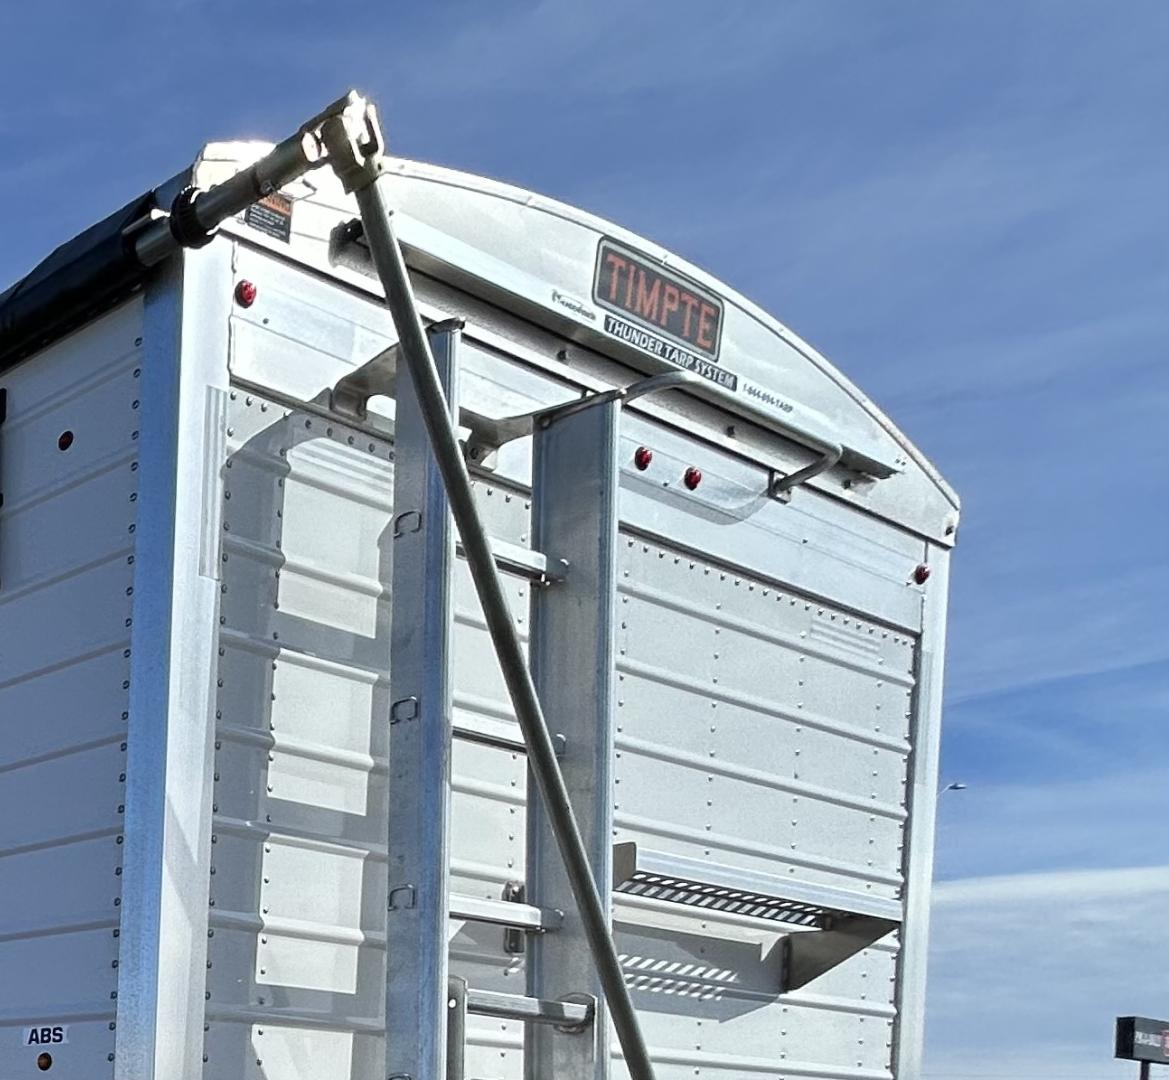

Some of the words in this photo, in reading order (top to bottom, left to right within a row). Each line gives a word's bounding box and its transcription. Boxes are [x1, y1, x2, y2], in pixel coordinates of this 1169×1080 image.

[606, 253, 716, 349] TIMPTE
[607, 317, 662, 355] THUNDER
[664, 344, 693, 368] TARP
[693, 359, 735, 389] SYSTEM
[28, 1026, 64, 1045] ABS
